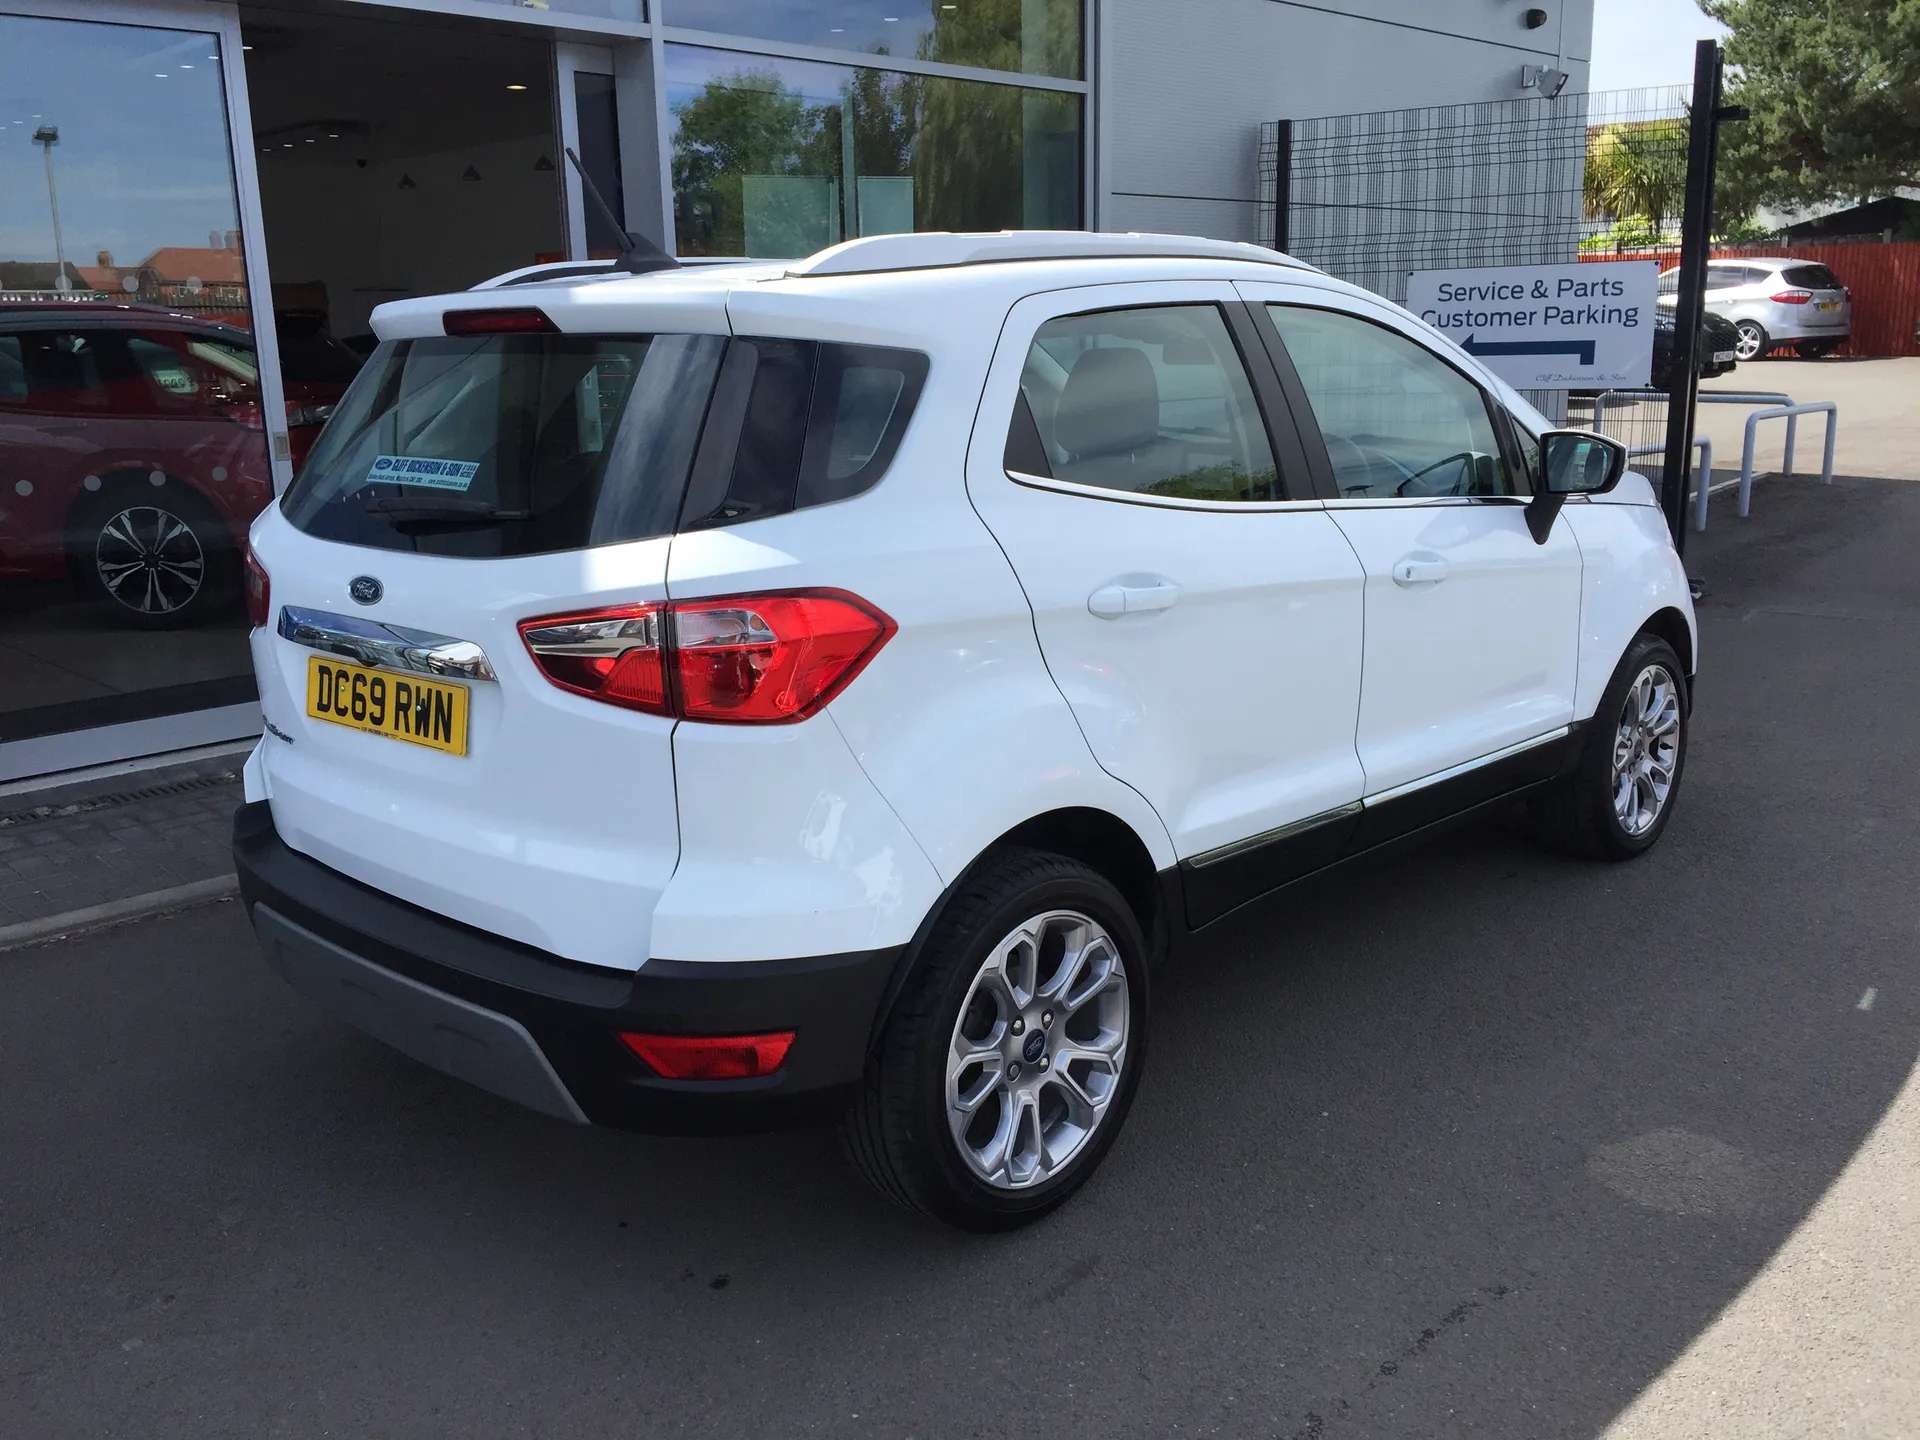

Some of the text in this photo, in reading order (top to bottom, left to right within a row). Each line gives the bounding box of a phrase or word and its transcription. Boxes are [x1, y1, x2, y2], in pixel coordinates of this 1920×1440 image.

[1438, 277, 1624, 302] Service & Parts
[1421, 304, 1639, 328] Customer Parking
[316, 664, 453, 744] DC69 RWN
